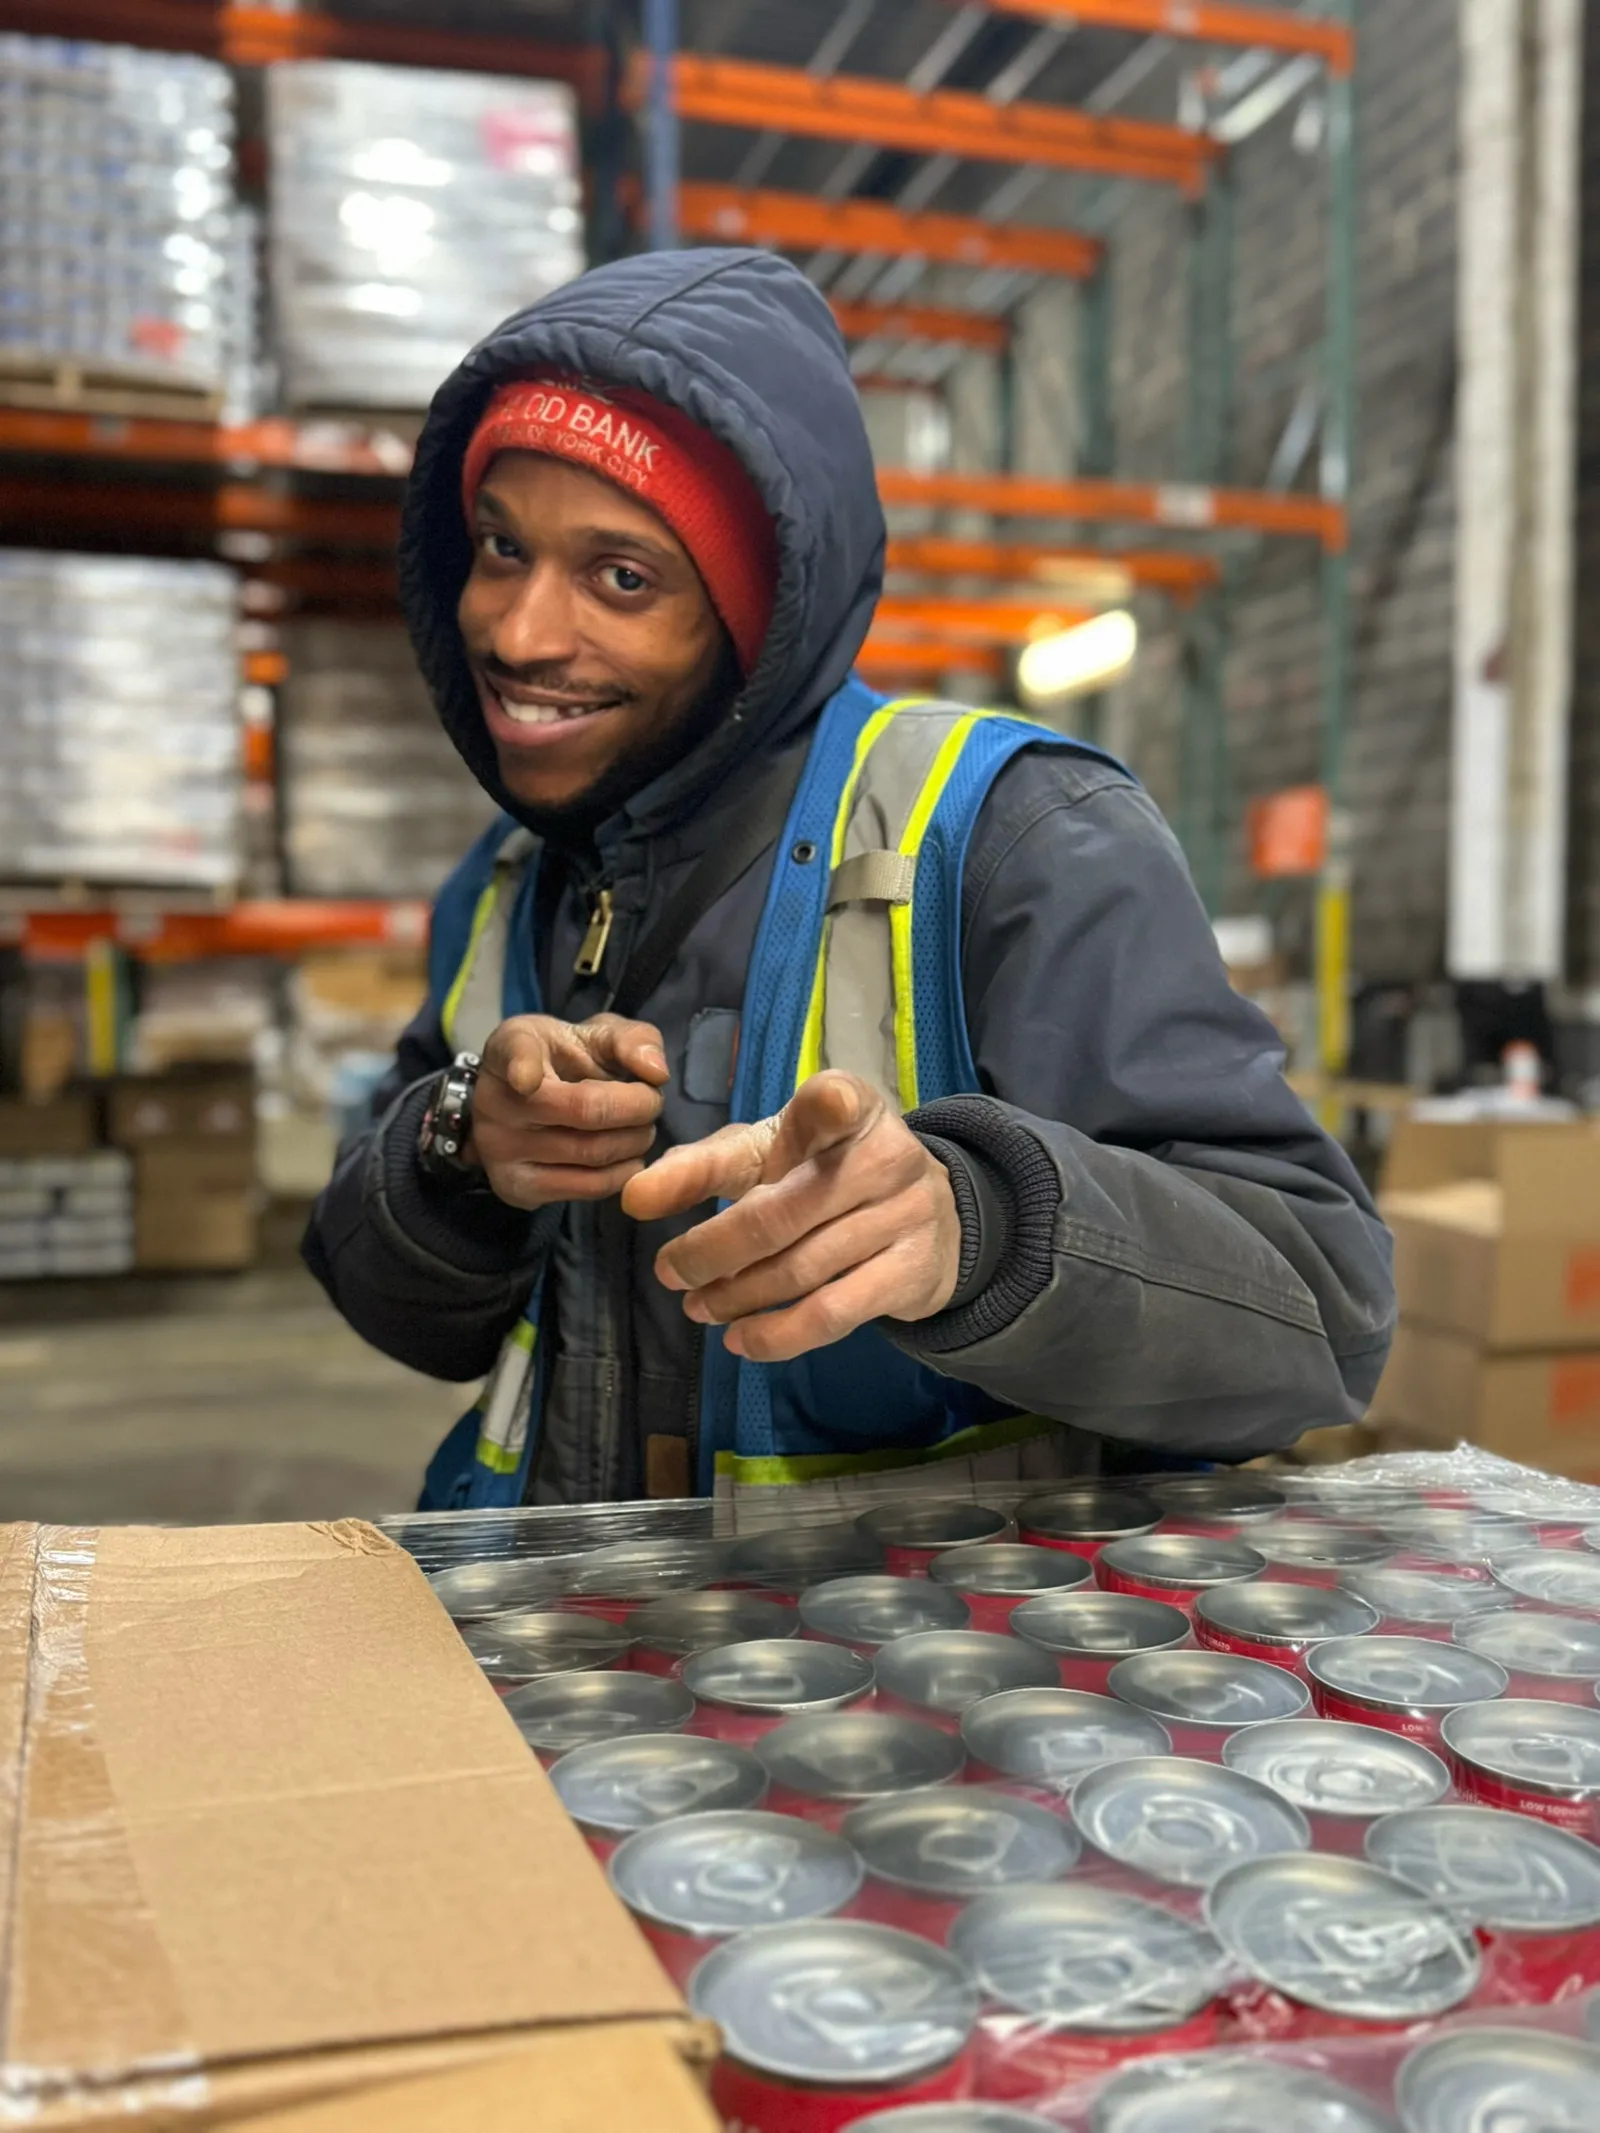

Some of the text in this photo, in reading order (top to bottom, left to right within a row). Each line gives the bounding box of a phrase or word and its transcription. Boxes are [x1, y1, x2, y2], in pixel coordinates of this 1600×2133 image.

[555, 431, 604, 463] YORK
[606, 454, 648, 490] CITY
[568, 403, 660, 471] BANK
[1520, 1799, 1546, 1813] LOW
